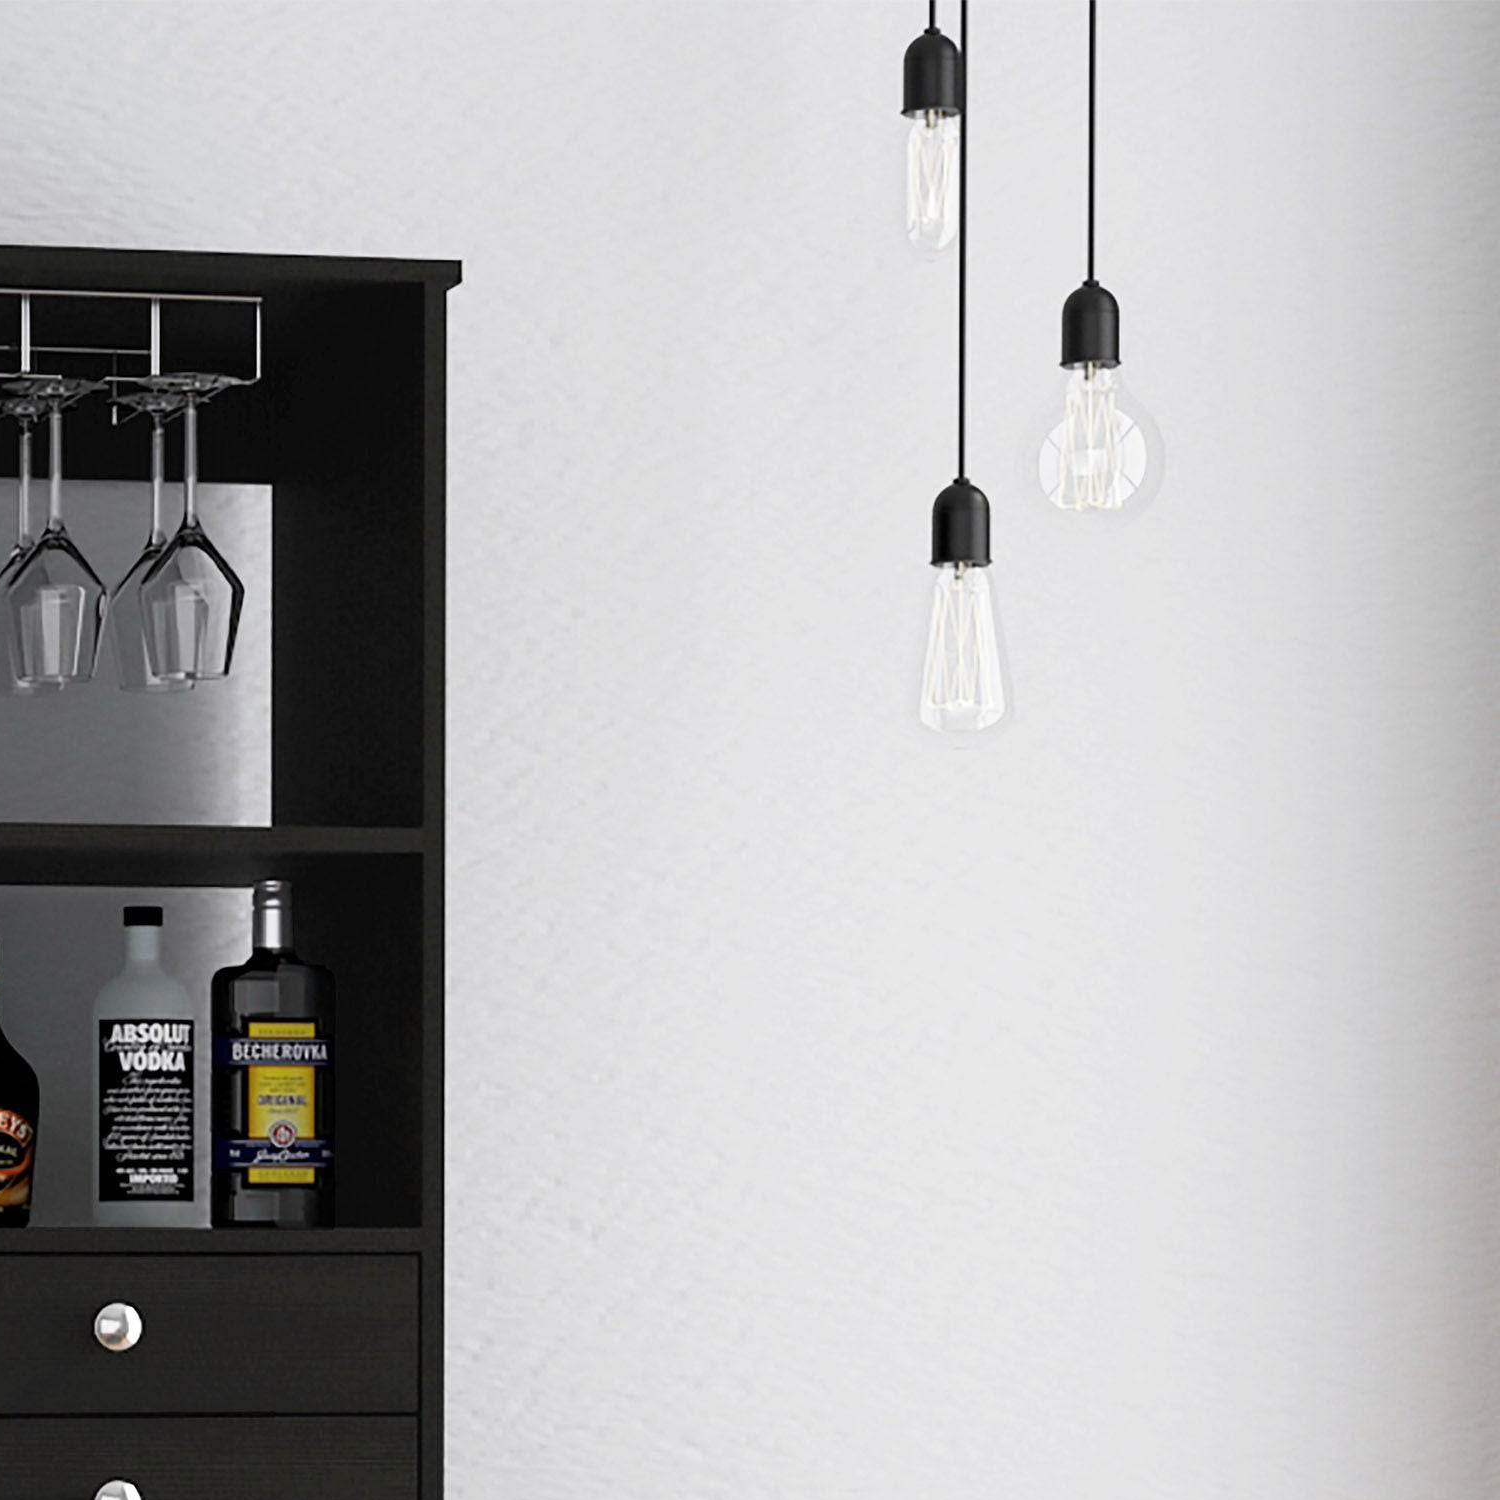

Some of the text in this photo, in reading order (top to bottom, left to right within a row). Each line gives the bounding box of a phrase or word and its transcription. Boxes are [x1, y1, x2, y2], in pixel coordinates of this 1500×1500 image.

[109, 1022, 191, 1044] ABSOLUT
[119, 1050, 186, 1072] VODKA
[232, 1042, 328, 1061] BECHEROVKA
